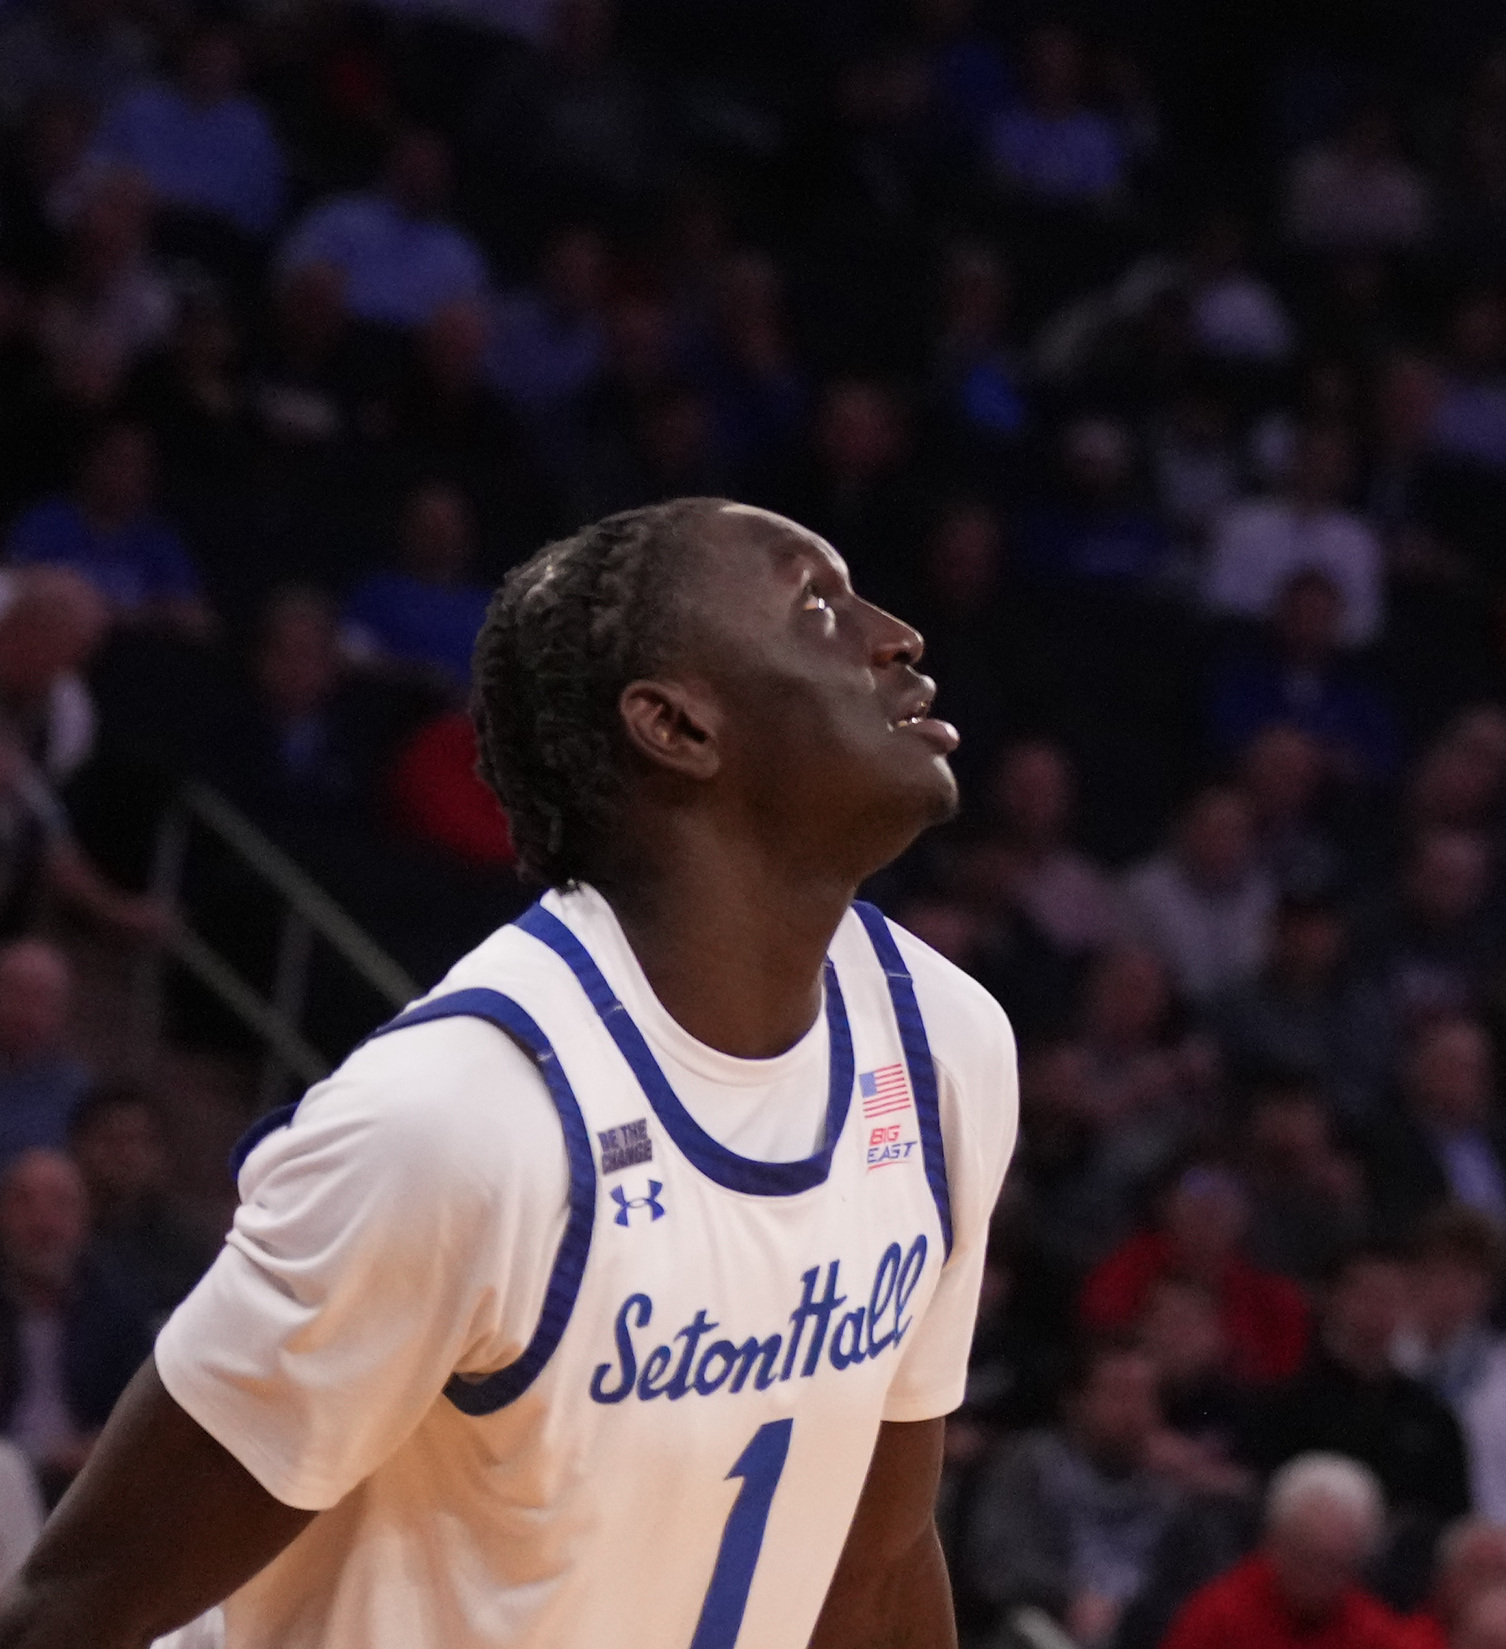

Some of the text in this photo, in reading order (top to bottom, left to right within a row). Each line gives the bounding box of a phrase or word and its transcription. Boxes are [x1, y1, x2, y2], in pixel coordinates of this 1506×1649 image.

[867, 1140, 917, 1164] EAST
[870, 1125, 900, 1146] BIG
[590, 1233, 928, 1405] Seton Hall
[688, 1417, 794, 1649] 1
